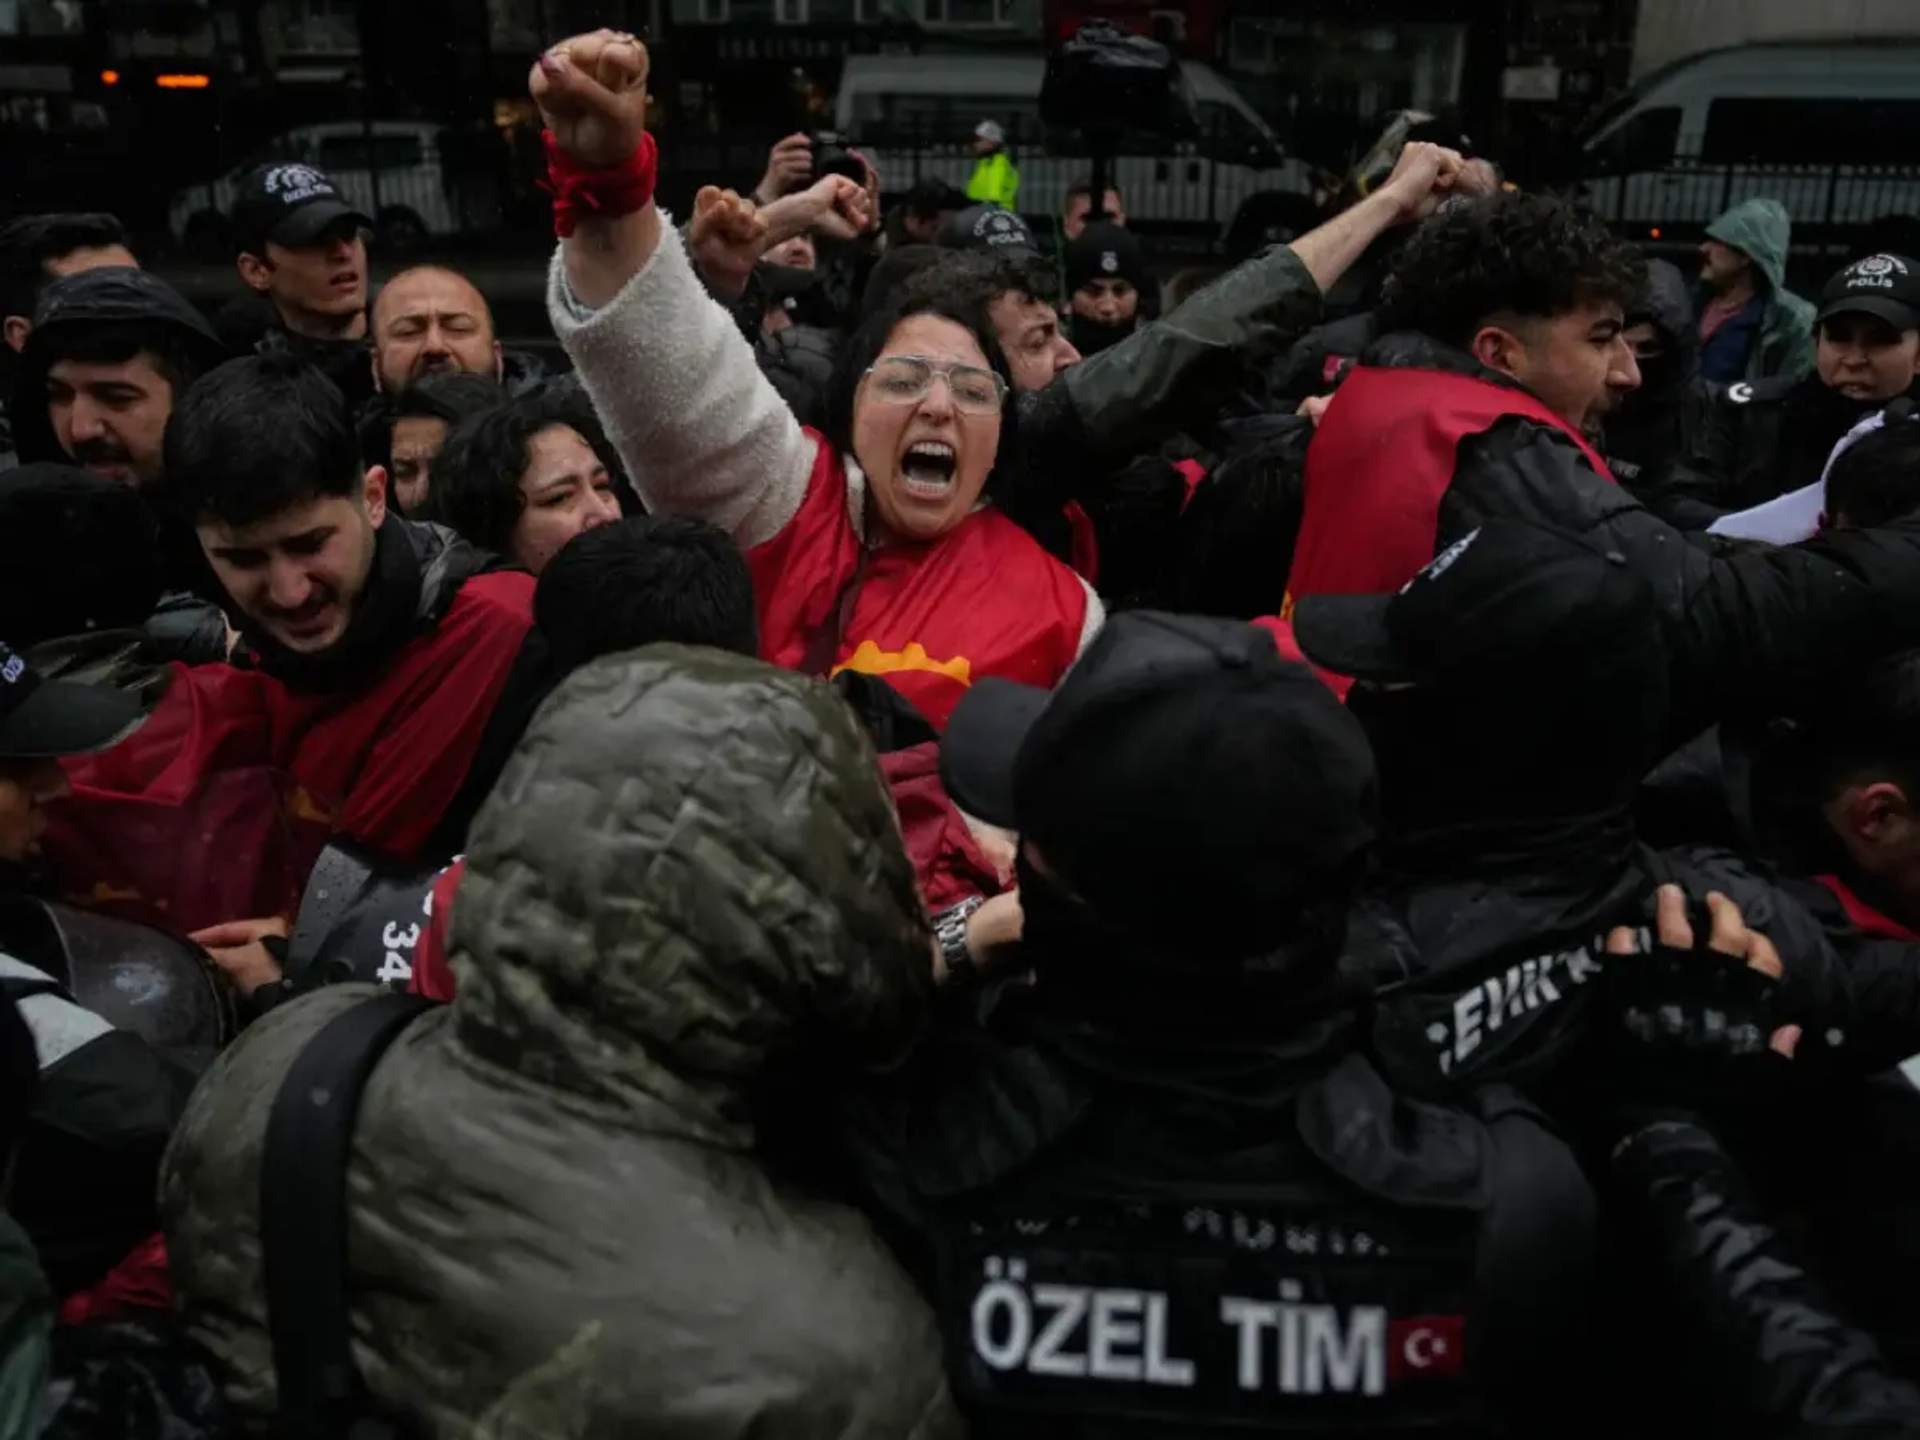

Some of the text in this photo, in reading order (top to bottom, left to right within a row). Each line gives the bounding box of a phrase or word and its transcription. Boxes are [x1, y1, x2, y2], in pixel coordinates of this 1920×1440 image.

[376, 920, 420, 982] 34
[971, 1256, 1389, 1397] ÖZEL TİM
